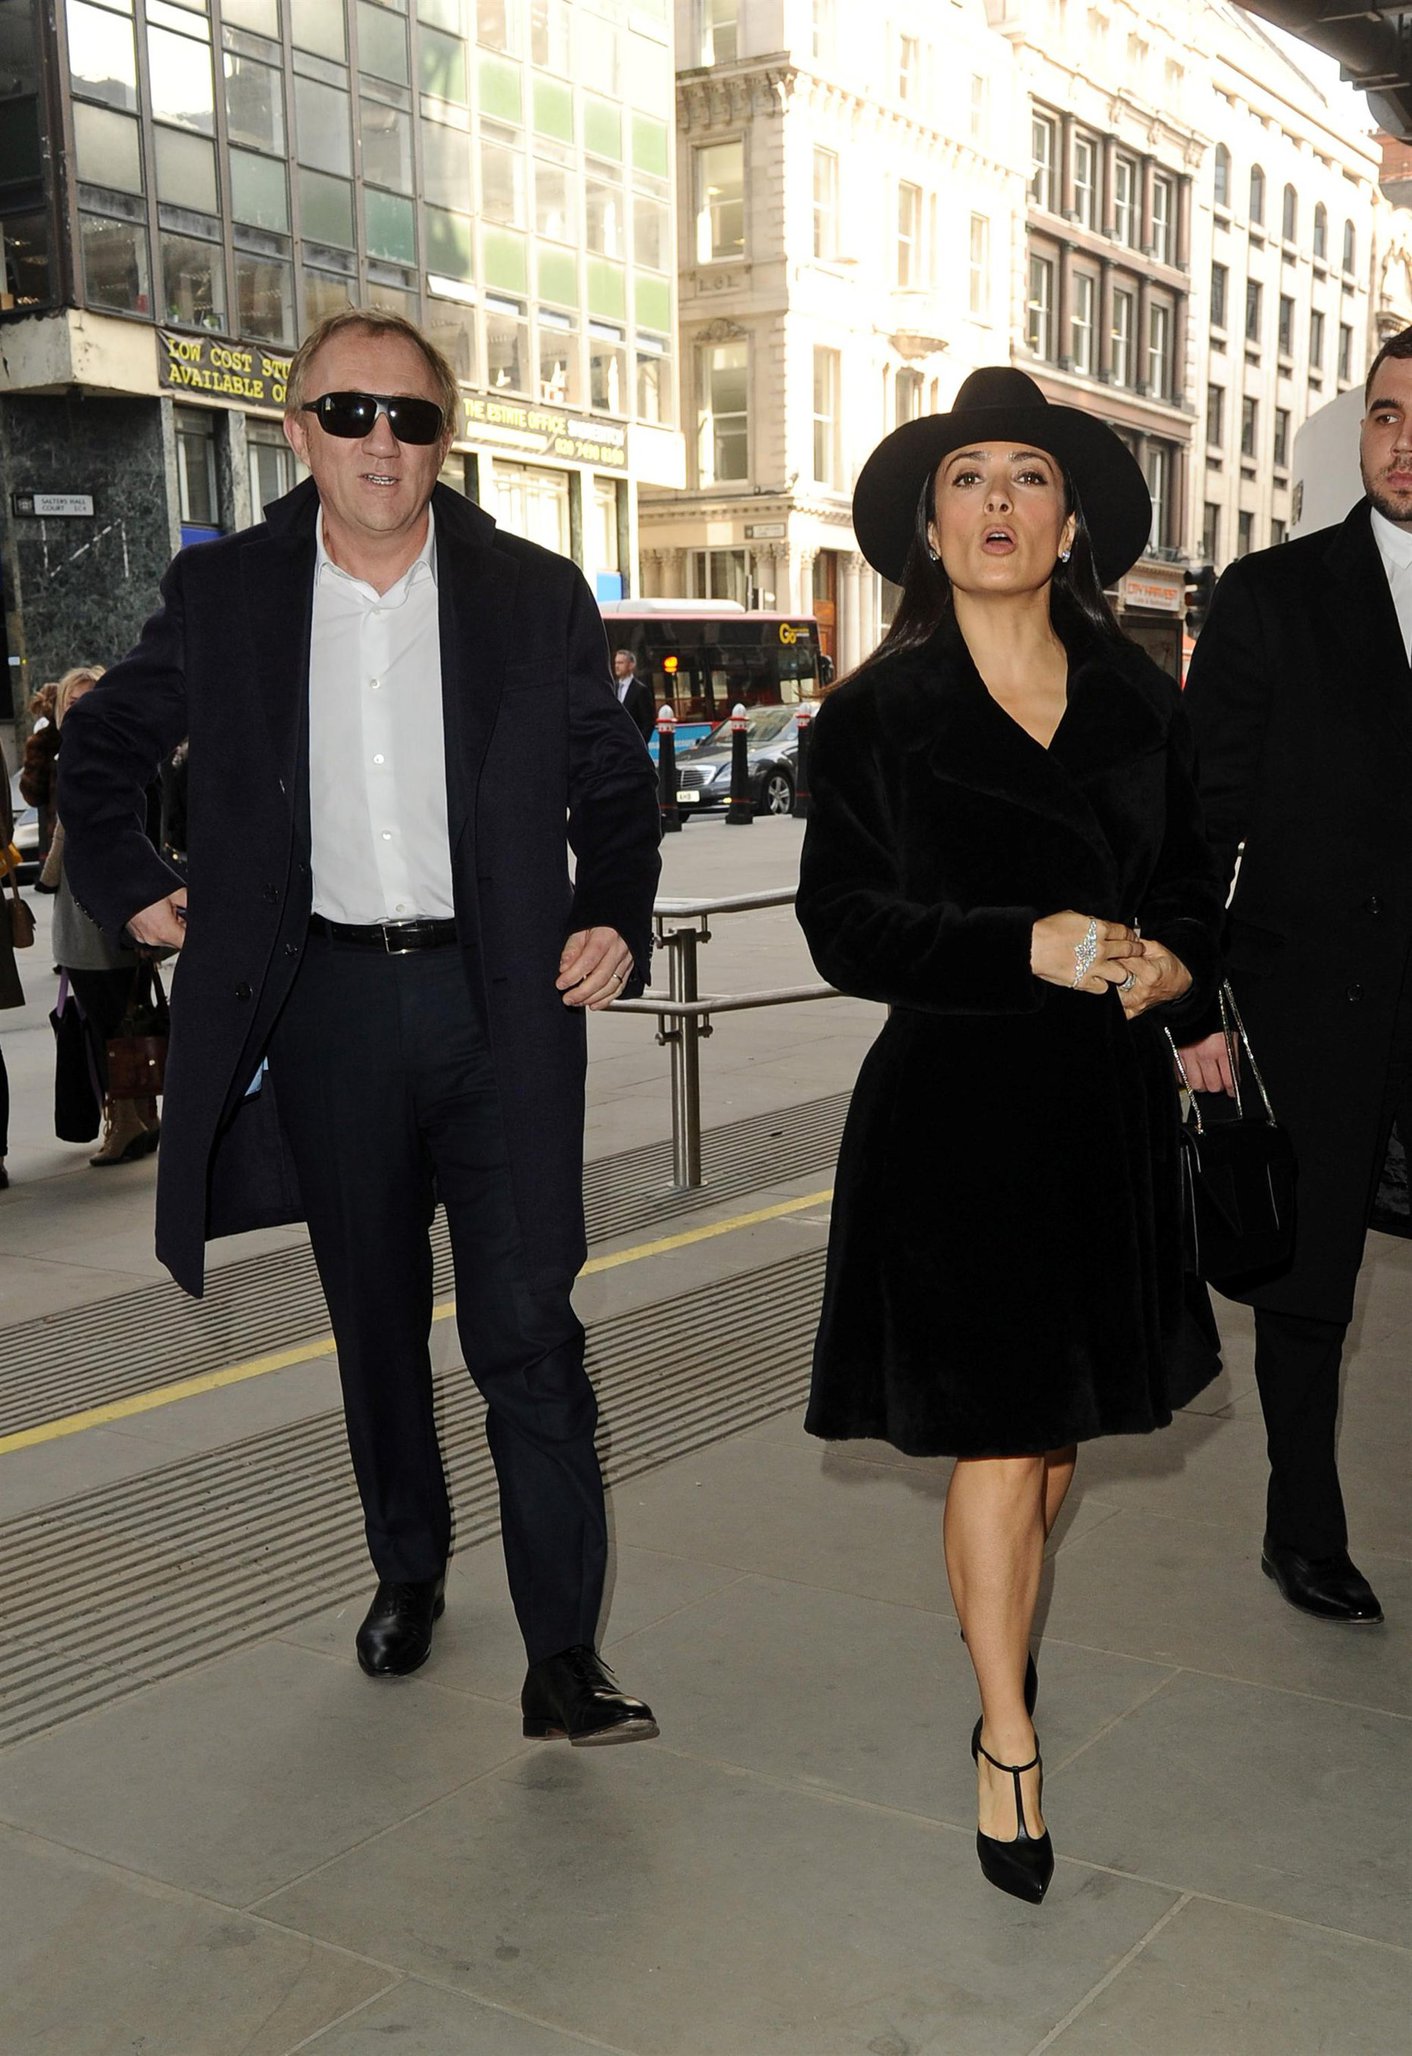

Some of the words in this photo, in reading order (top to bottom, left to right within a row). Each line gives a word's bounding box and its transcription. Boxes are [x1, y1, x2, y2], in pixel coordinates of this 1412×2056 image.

[168, 339, 202, 361] LOW
[210, 348, 252, 372] COST
[169, 363, 264, 399] AVAILABLE
[463, 398, 485, 419] THE
[487, 402, 528, 428] ESTATE
[527, 410, 567, 435] OFFICE
